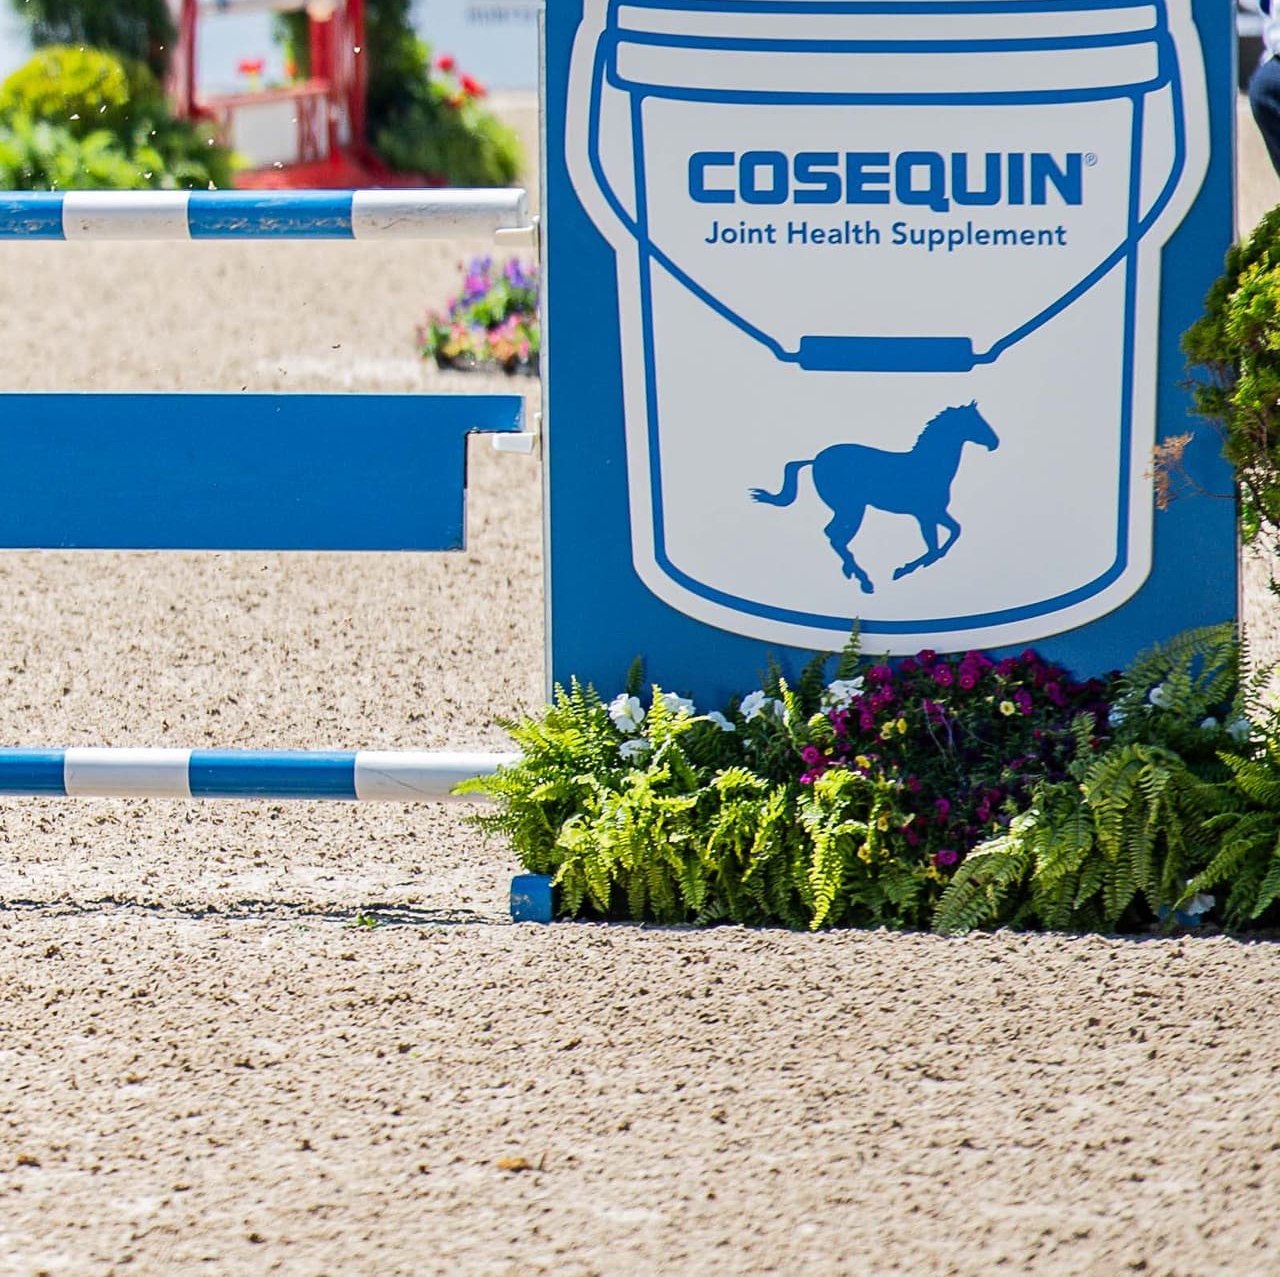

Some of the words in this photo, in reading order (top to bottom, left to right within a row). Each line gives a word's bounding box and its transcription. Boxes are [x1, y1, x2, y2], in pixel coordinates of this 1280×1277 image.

[704, 220, 777, 245] Joint
[787, 220, 880, 245] Health
[891, 221, 1067, 252] Supplement
